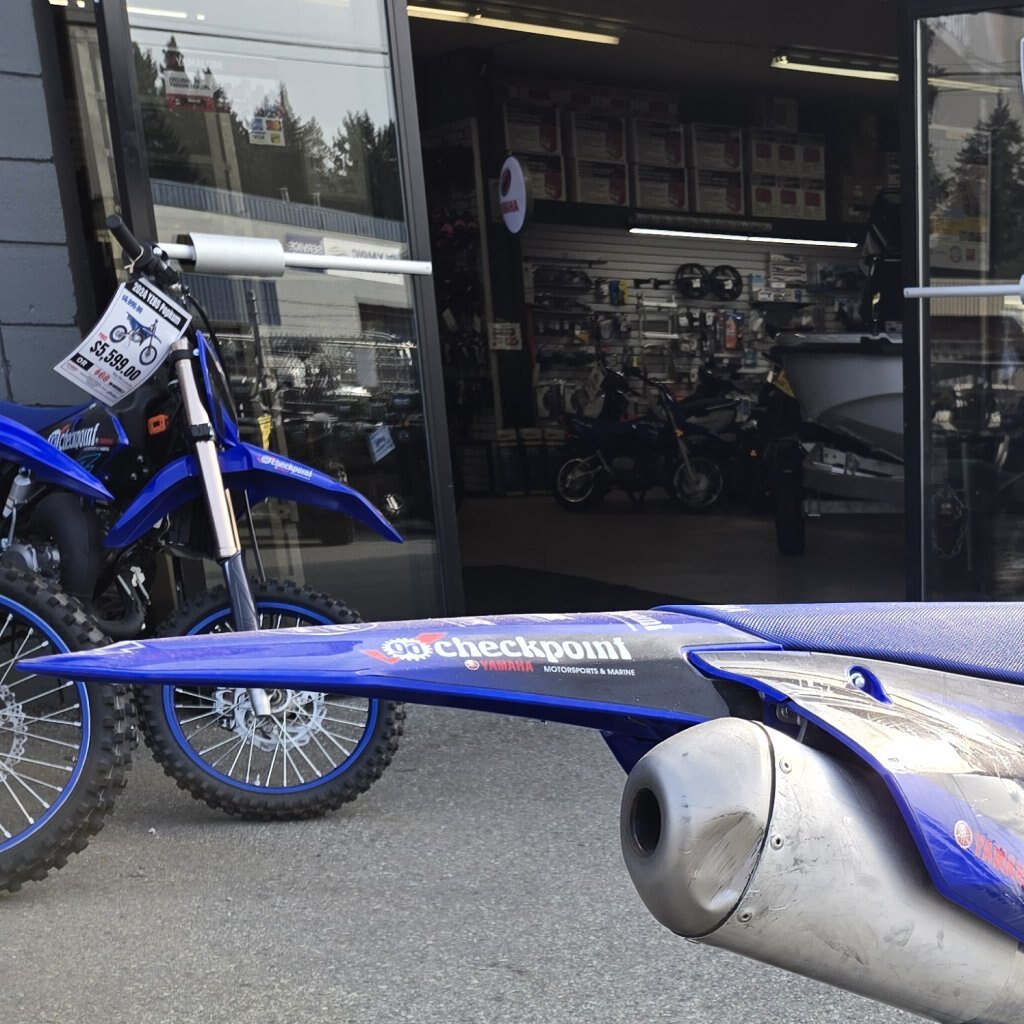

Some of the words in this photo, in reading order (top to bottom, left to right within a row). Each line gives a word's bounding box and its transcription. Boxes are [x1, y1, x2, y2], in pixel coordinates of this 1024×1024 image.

[131, 281, 147, 299] 2024
[76, 356, 88, 367] OR
[90, 340, 141, 382] $5,599.00
[434, 635, 632, 663] checkpoint
[481, 660, 534, 673] YAMAHA
[543, 665, 598, 676] MOTORSPORTS
[600, 667, 606, 675] &
[607, 668, 636, 677] MARINE
